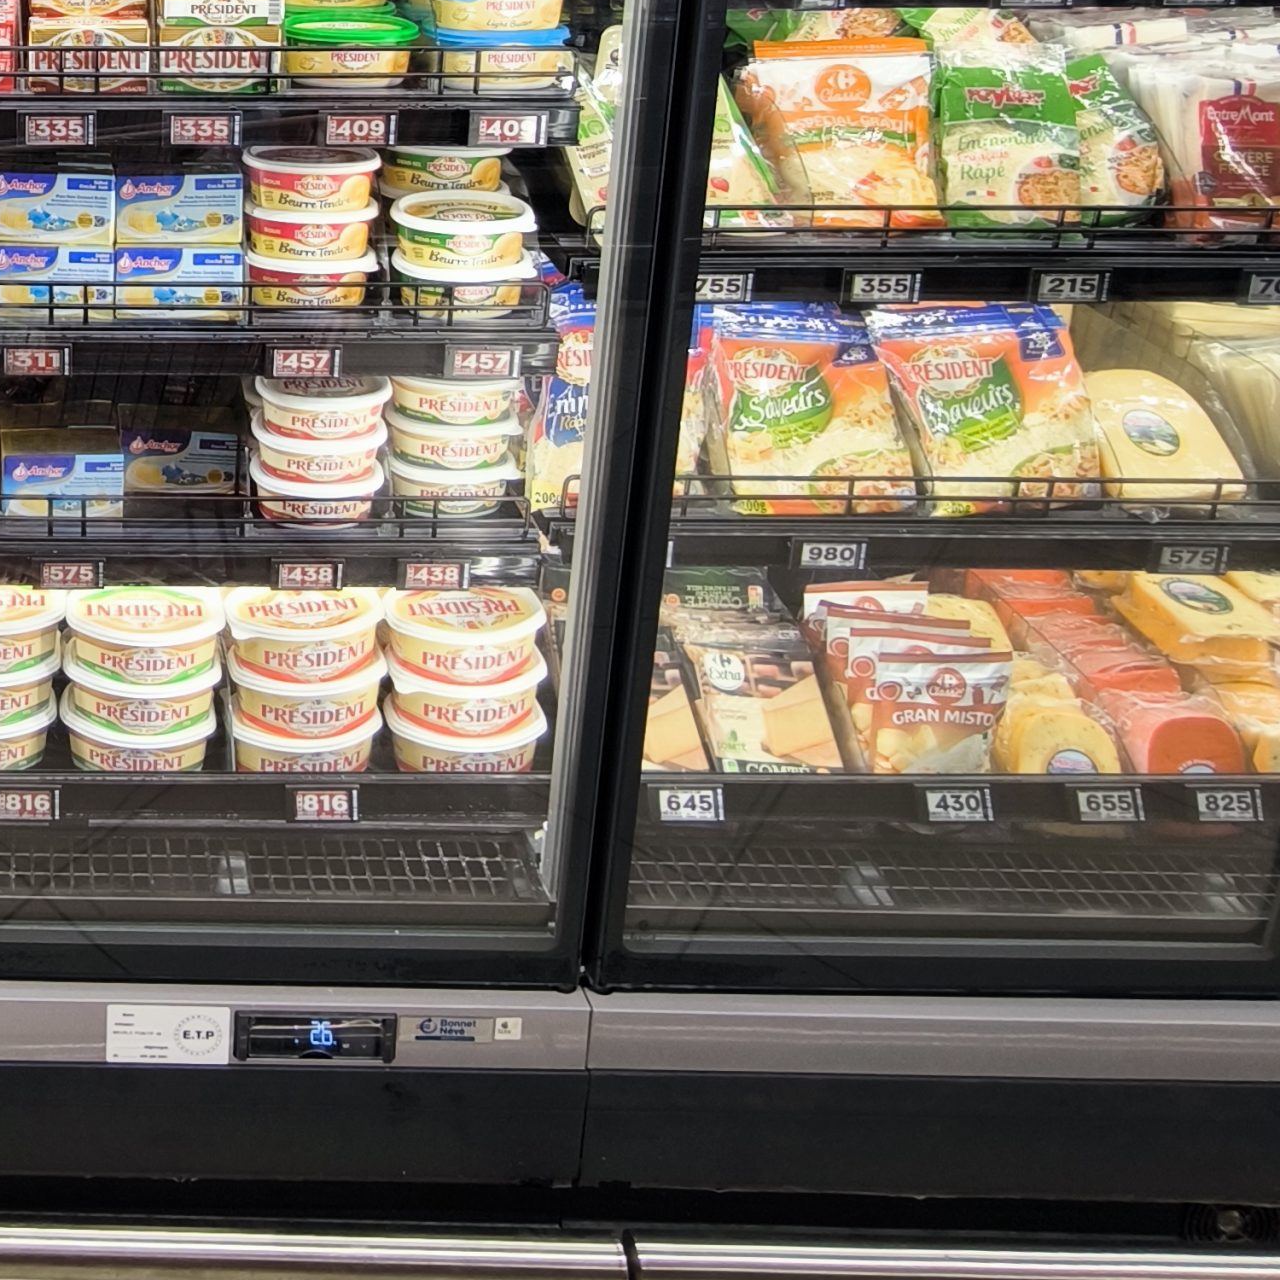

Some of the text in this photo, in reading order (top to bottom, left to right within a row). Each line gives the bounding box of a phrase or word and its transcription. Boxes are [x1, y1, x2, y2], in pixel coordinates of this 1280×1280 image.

[191, 4, 256, 14] PRÉSIDENT
[35, 121, 83, 136] 335
[181, 121, 229, 136] 335
[338, 120, 386, 136] 409
[6, 180, 47, 193] Anchor
[410, 173, 483, 190] Beurre Tendre
[278, 193, 317, 208] Beurre
[860, 275, 908, 294] 355
[1048, 275, 1096, 294] 215
[13, 352, 61, 369] 311
[283, 353, 329, 369] 457
[461, 354, 507, 369] 457
[907, 358, 994, 382] PRÉSIDENT
[419, 397, 499, 413] PRÉSIDENT
[421, 443, 499, 459] PRÉSIDENT
[808, 547, 855, 562] 980
[1168, 550, 1215, 566] 575
[48, 564, 94, 581] 575
[288, 566, 332, 581] 438
[413, 566, 458, 581] 438
[892, 709, 993, 727] GRAN MISTO
[5, 794, 50, 810] 816
[303, 795, 348, 810] 816
[666, 795, 713, 812] 645
[934, 795, 981, 813] 430
[1085, 793, 1133, 811] 655
[1204, 793, 1251, 812] 825
[439, 1028, 465, 1036] Névé
[440, 1020, 476, 1029] Bonnet
[183, 1029, 215, 1041] E.T.P
